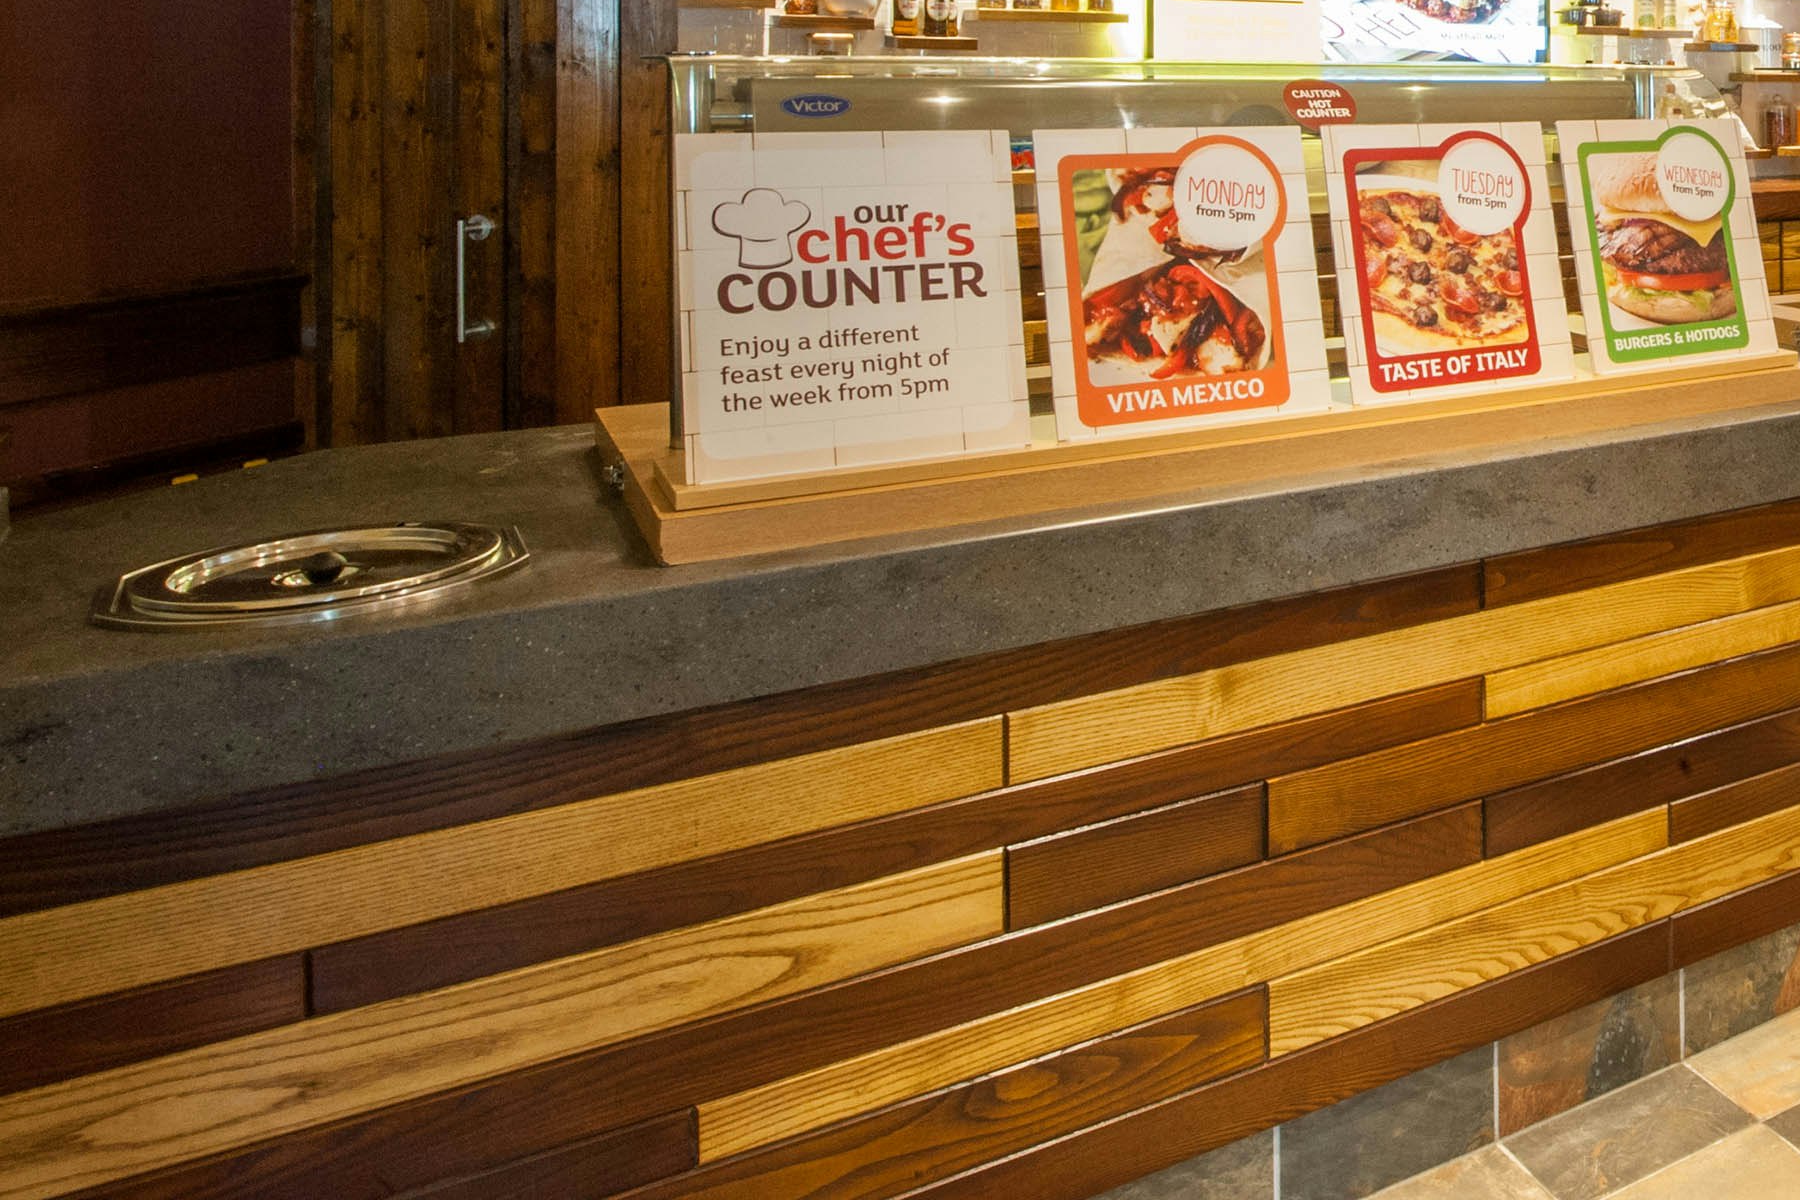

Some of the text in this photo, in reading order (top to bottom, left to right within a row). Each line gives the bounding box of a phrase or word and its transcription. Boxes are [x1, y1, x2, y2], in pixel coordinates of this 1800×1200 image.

[791, 99, 843, 112] Victor
[1291, 89, 1341, 99] CAUTION
[1308, 99, 1332, 109] HOT
[1296, 108, 1352, 119] COUNTER
[1451, 167, 1514, 198] TUESDAY
[1663, 163, 1723, 189] WEDNESDAY
[1188, 176, 1265, 210] MONDAY
[1457, 193, 1507, 210] from 5pm
[1672, 184, 1714, 198] from 5pm
[853, 203, 909, 224] our
[1196, 204, 1256, 222] from 5pm
[717, 261, 988, 314] COUNTER
[720, 324, 920, 359] Enjoy a different
[1614, 325, 1740, 351] BURGERS & HOTDOGS
[720, 347, 951, 386] feast every night of
[1378, 348, 1529, 383] TASTE OF ITALY
[722, 377, 950, 413] the week from 5pm
[1106, 377, 1265, 413] VIVA MEXICO
